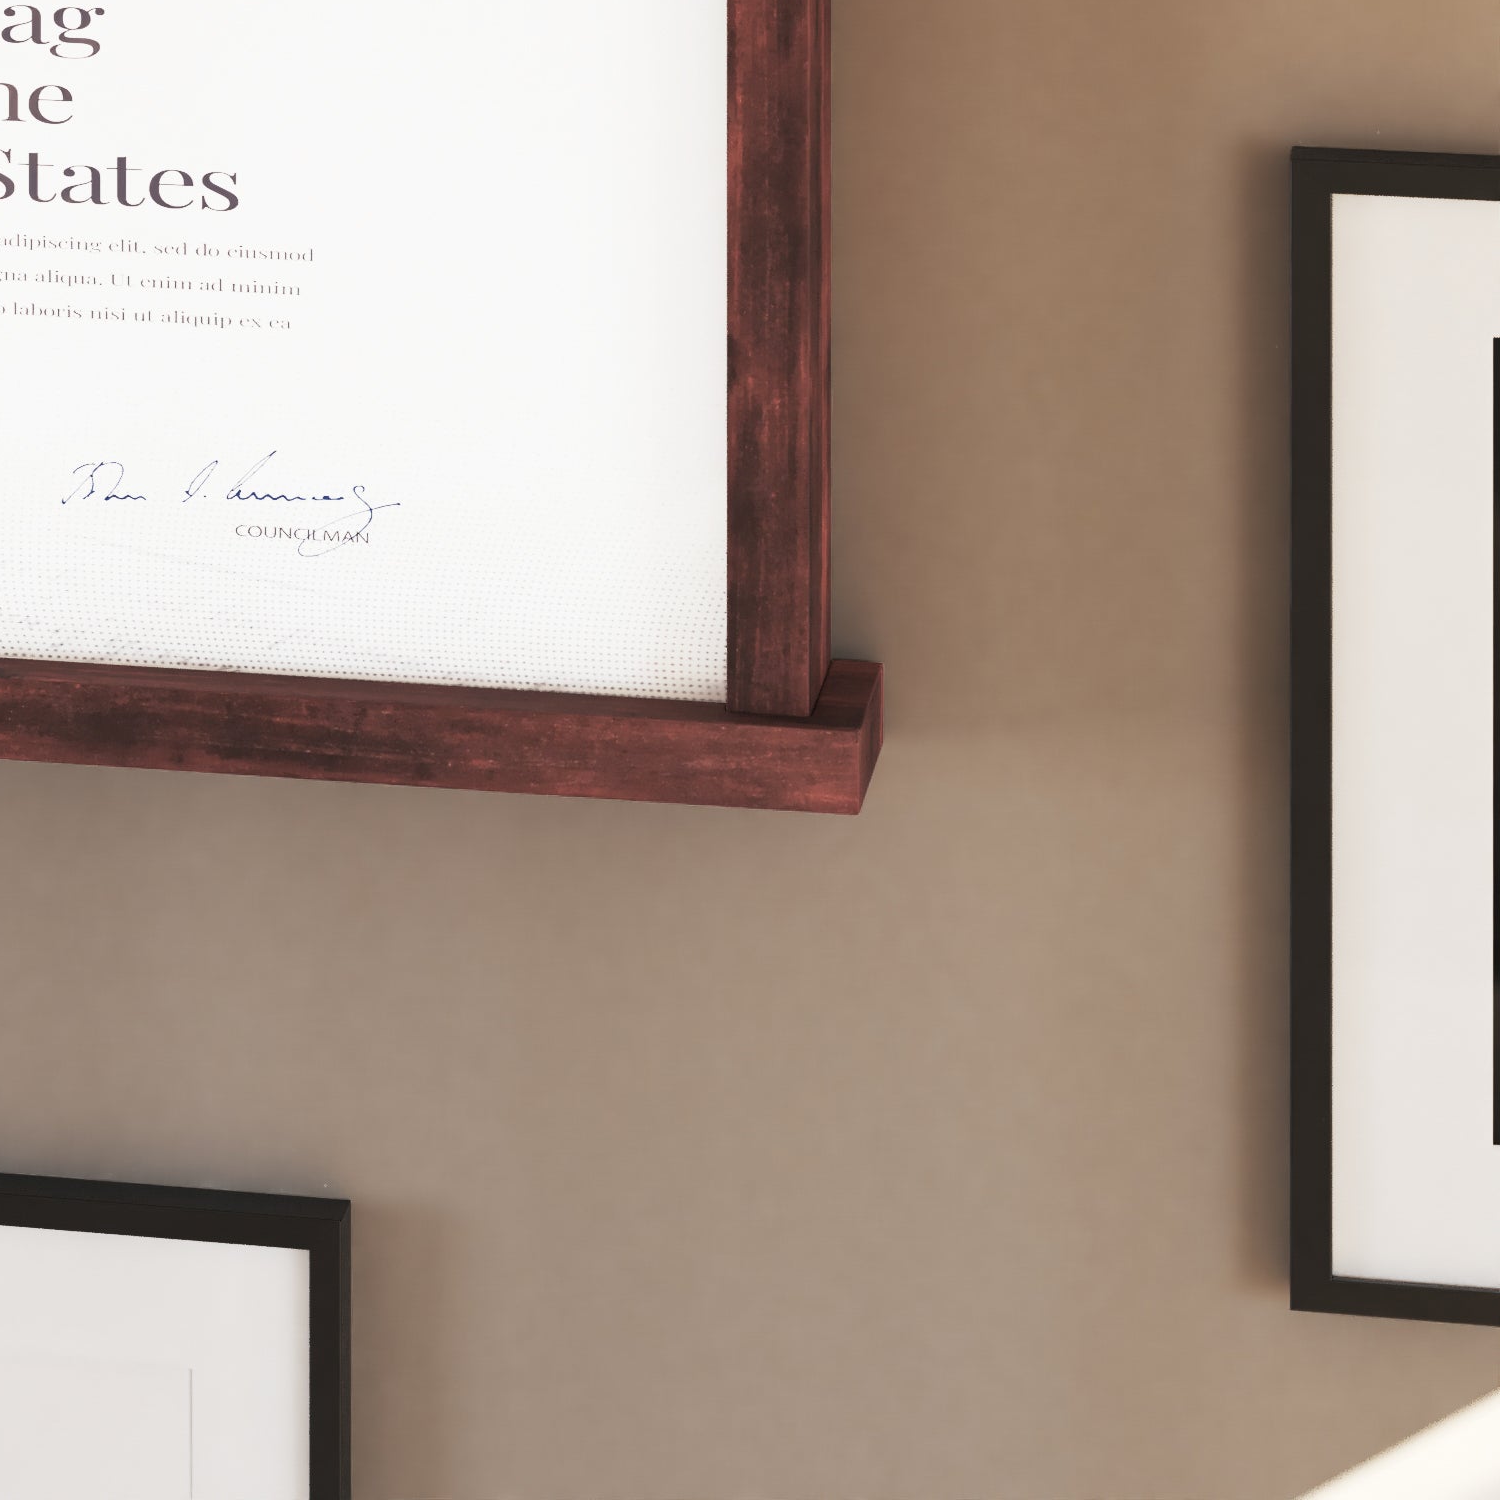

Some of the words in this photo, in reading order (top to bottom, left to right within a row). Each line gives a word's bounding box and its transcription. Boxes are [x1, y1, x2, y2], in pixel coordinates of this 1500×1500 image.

[153, 241, 187, 257] sed
[195, 242, 221, 258] do
[227, 243, 314, 262] eiusmod
[34, 269, 103, 289] aliqua.
[111, 273, 132, 288] Ut
[139, 275, 193, 293] enim
[199, 276, 224, 293] ad
[231, 279, 301, 297] minim
[13, 301, 84, 319] laboris
[90, 306, 125, 323] nisi
[133, 308, 156, 325] ut
[160, 309, 232, 330] aliquip
[239, 316, 262, 329] ex
[268, 315, 291, 331] ea
[234, 524, 370, 544] COUNCILMAN
